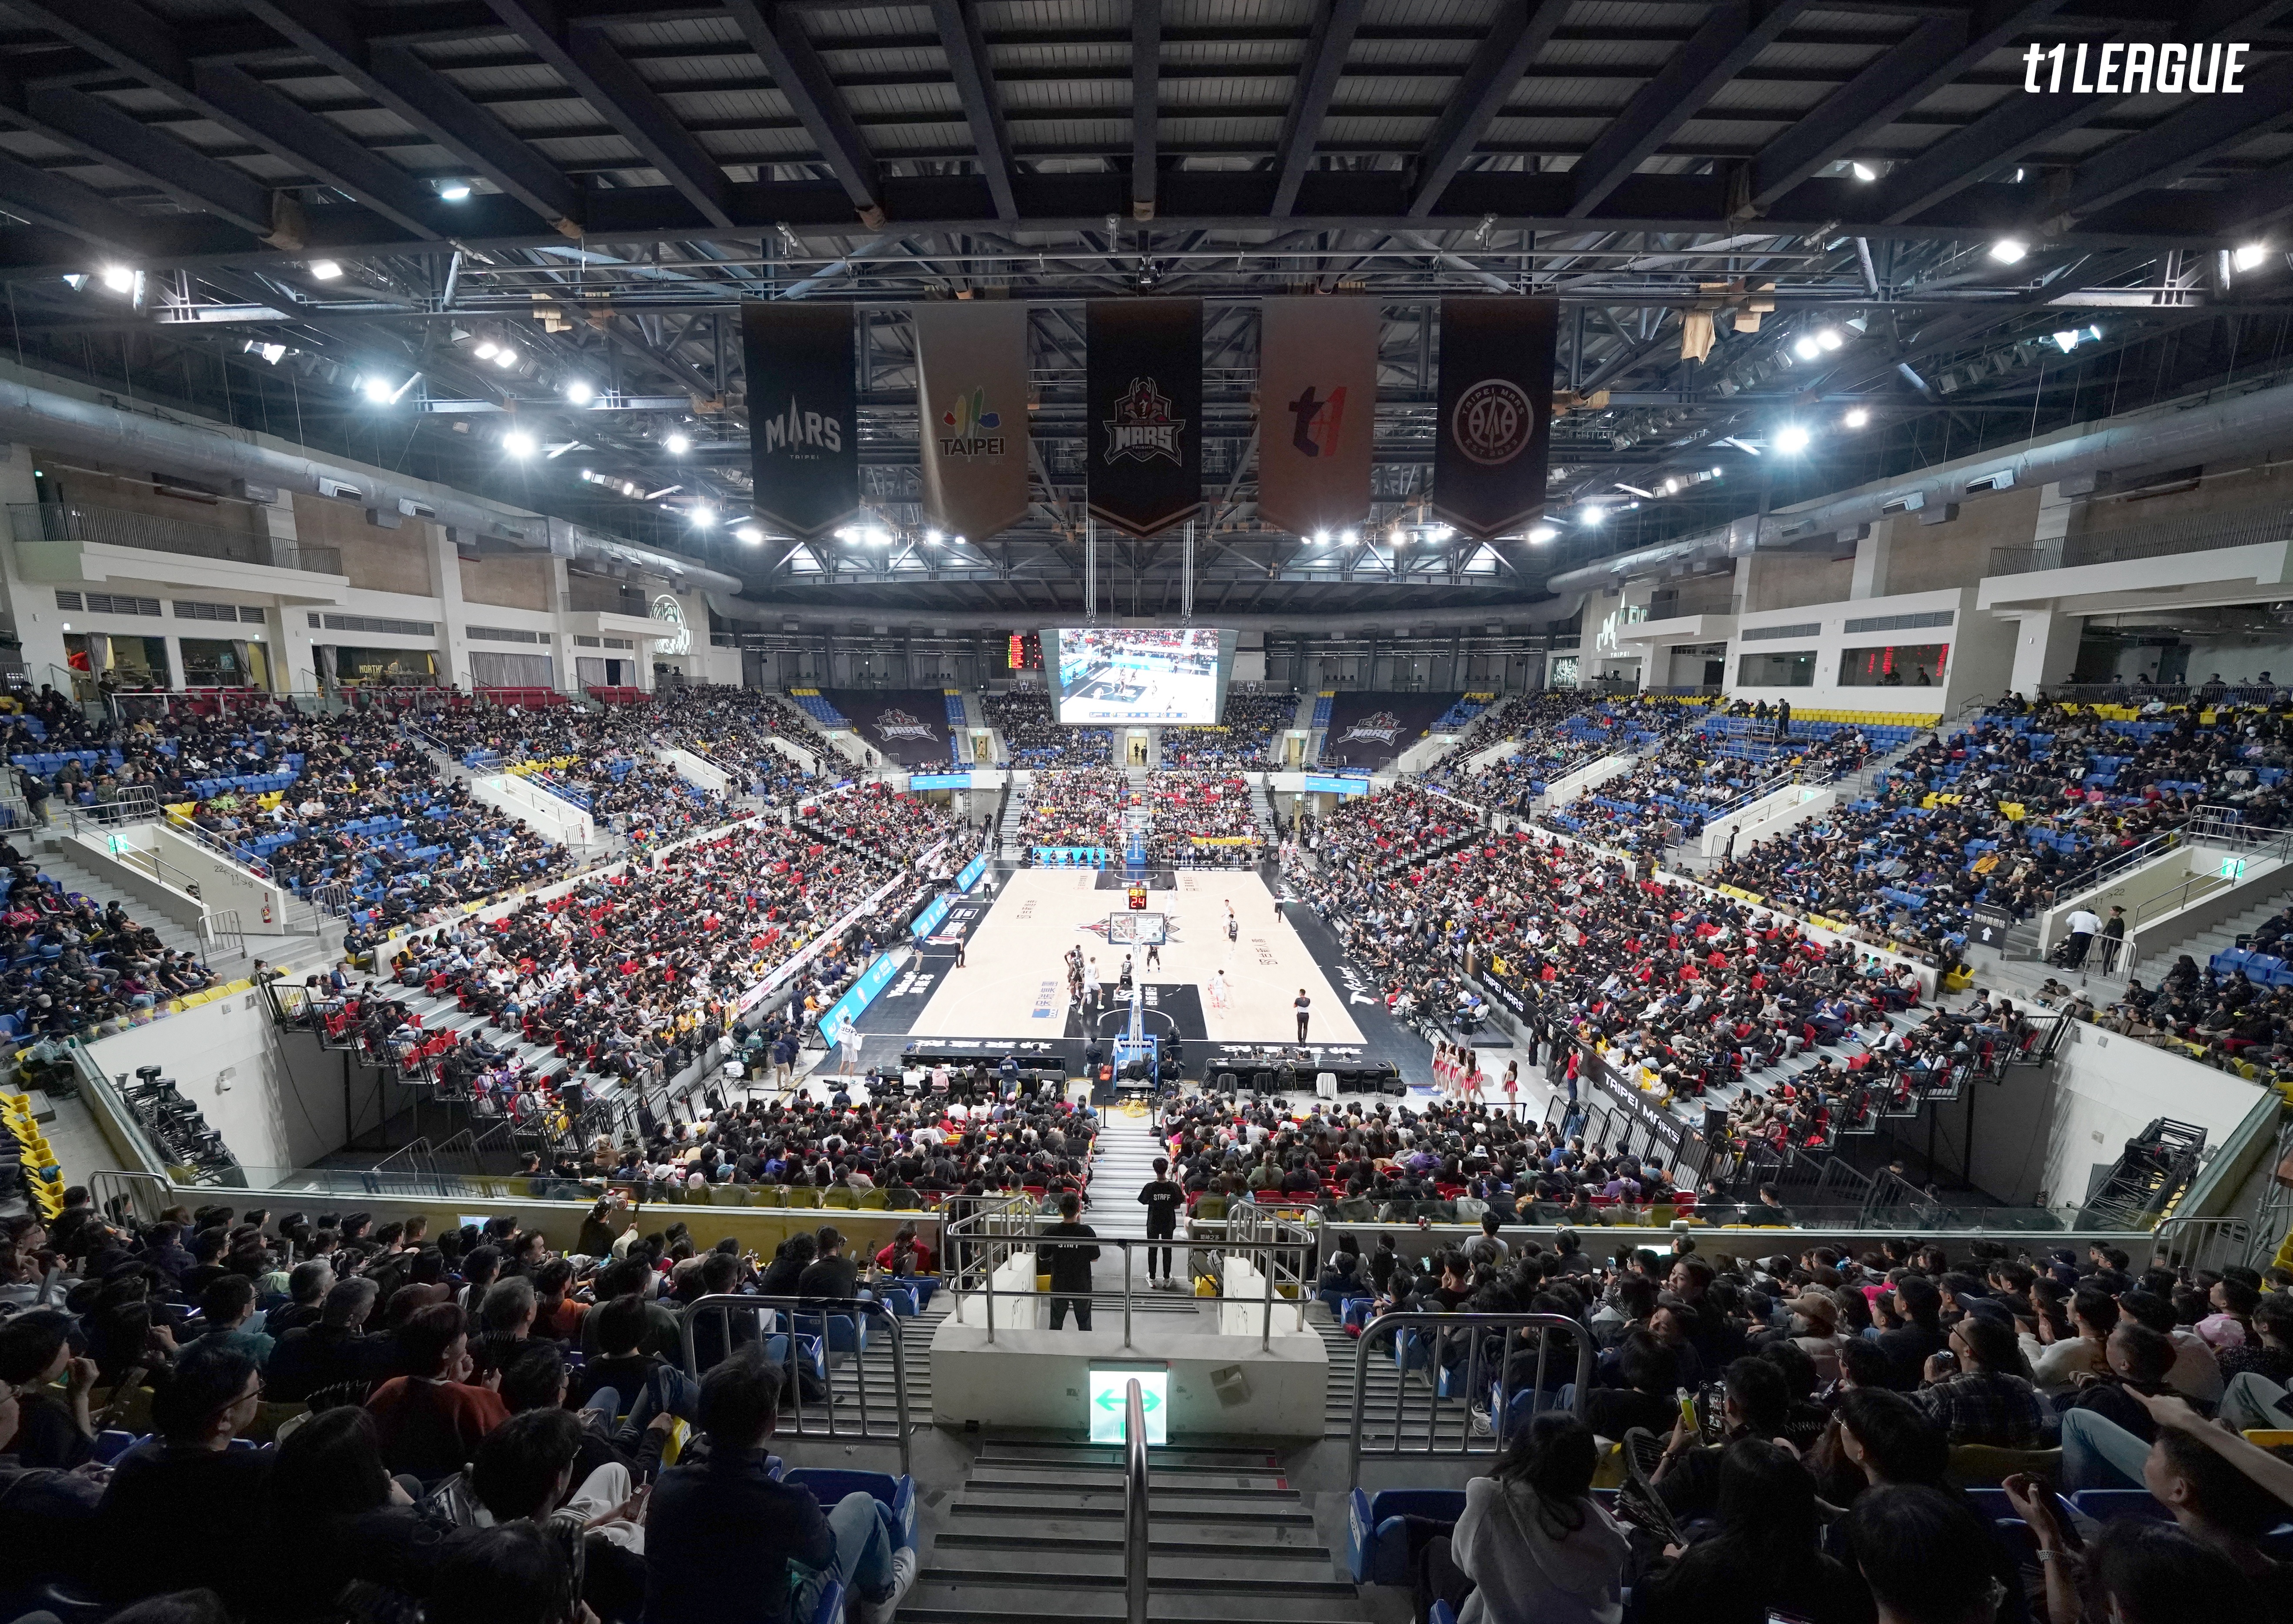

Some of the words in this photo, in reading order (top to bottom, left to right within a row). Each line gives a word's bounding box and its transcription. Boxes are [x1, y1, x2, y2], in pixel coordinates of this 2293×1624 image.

[1462, 387, 1495, 415] TAIPEI
[1501, 389, 1525, 414] MARS
[765, 393, 841, 453] MARS
[939, 436, 1005, 456] TAIPEI
[1112, 426, 1176, 454] MARS
[885, 726, 928, 737] MARS
[1349, 729, 1397, 740] MARS
[1130, 897, 1145, 908] 24
[1335, 965, 1369, 992] Richart
[1482, 971, 1501, 994] TAIPEI
[1503, 988, 1524, 1012] MARS
[1035, 981, 1058, 1007] 保瑞集團
[1145, 986, 1157, 1006] 台新銀行
[1604, 1071, 1639, 1110] TAIPEI
